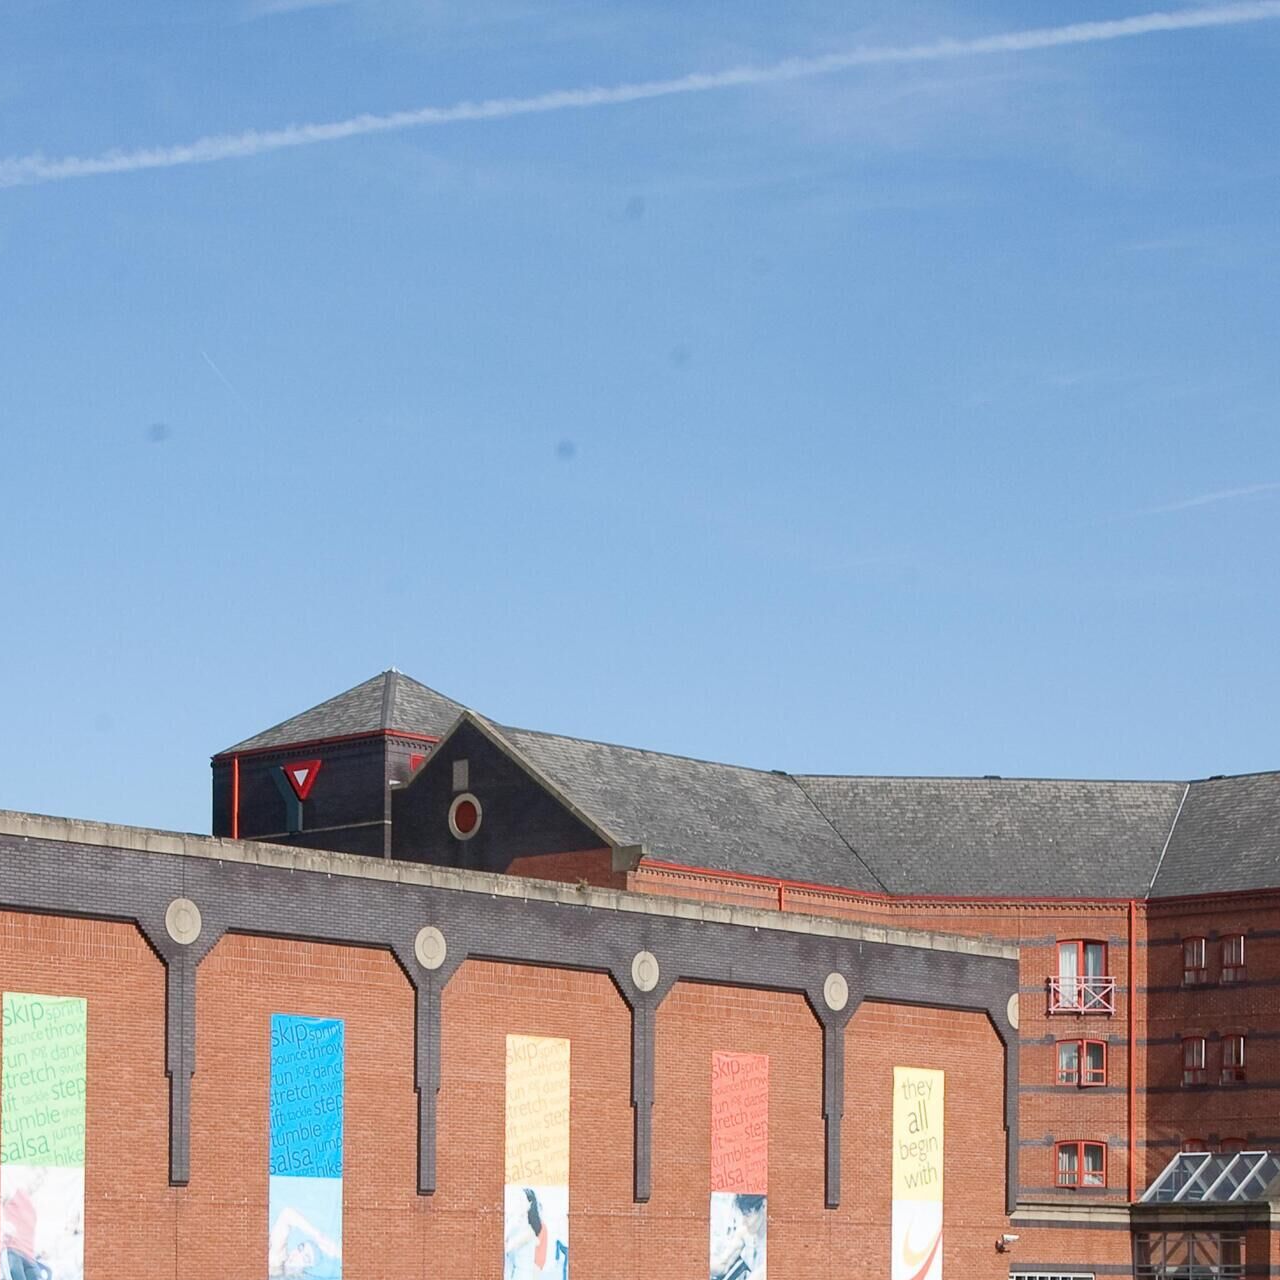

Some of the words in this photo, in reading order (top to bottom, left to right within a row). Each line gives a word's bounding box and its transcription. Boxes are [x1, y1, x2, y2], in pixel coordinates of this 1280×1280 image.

[3, 997, 44, 1029] skip
[272, 1018, 308, 1049] skip
[506, 1038, 537, 1066] skip
[712, 1056, 740, 1081] skip
[52, 1077, 86, 1101] step
[902, 1077, 933, 1100] they
[3, 1105, 61, 1134] tumble
[271, 1108, 286, 1129] ift
[314, 1095, 343, 1117] step
[908, 1099, 928, 1134] all
[272, 1120, 321, 1147] tumble
[1, 1132, 50, 1164] salsa
[270, 1145, 312, 1175] salsa
[899, 1136, 938, 1161] begin
[711, 1166, 744, 1190] salsa
[904, 1162, 938, 1189] with
